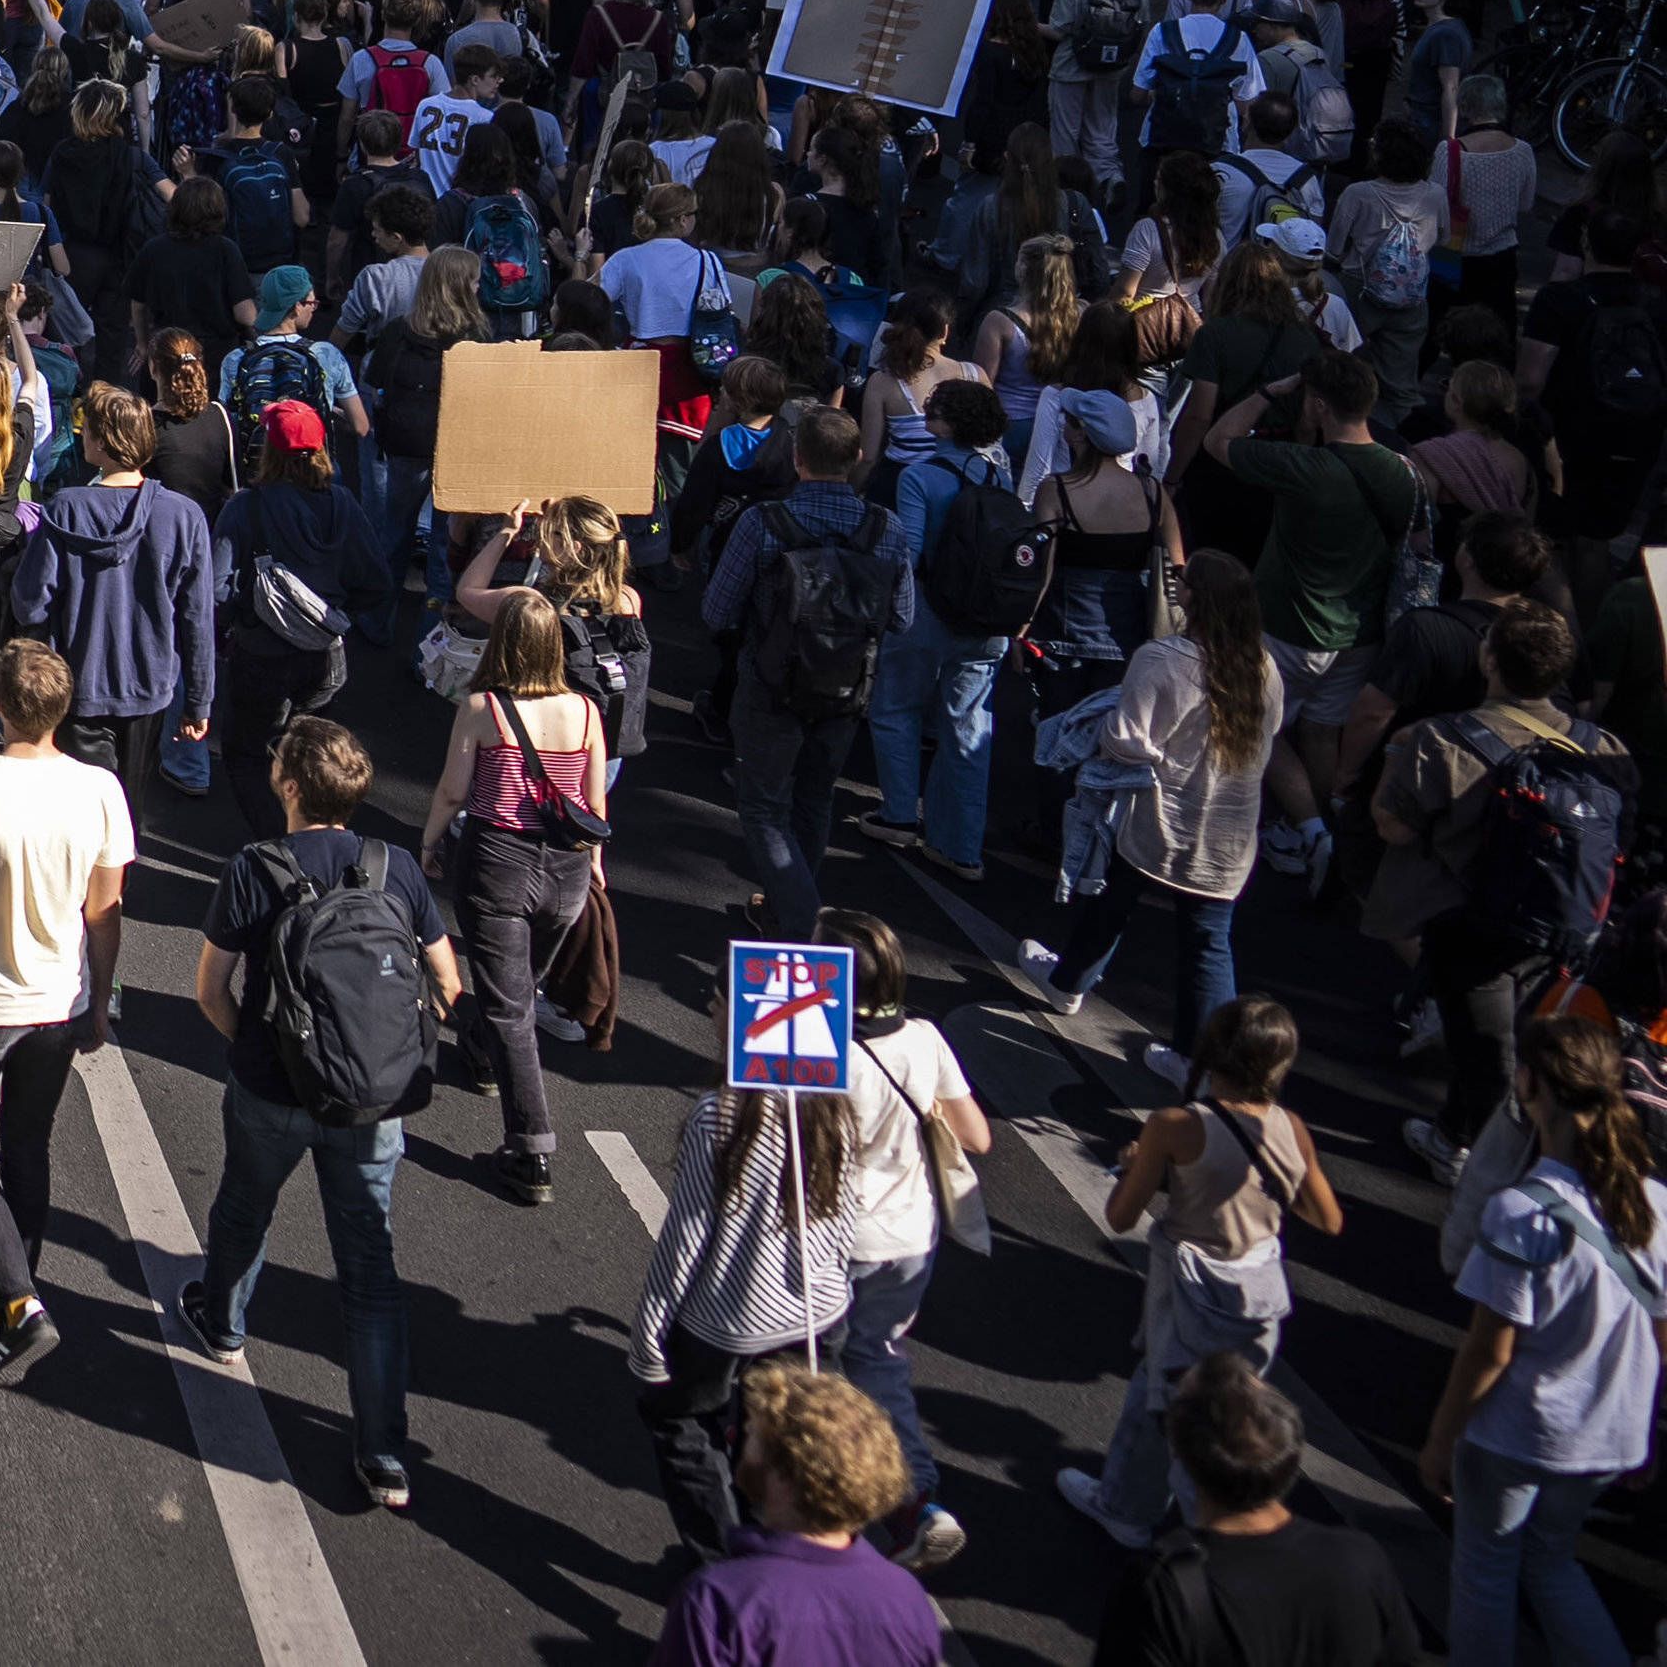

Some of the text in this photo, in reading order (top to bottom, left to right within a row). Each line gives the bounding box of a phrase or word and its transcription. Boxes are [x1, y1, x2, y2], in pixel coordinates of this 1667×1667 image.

[419, 105, 470, 157] 23
[740, 958, 839, 988] STOP
[743, 1057, 838, 1086] A100
